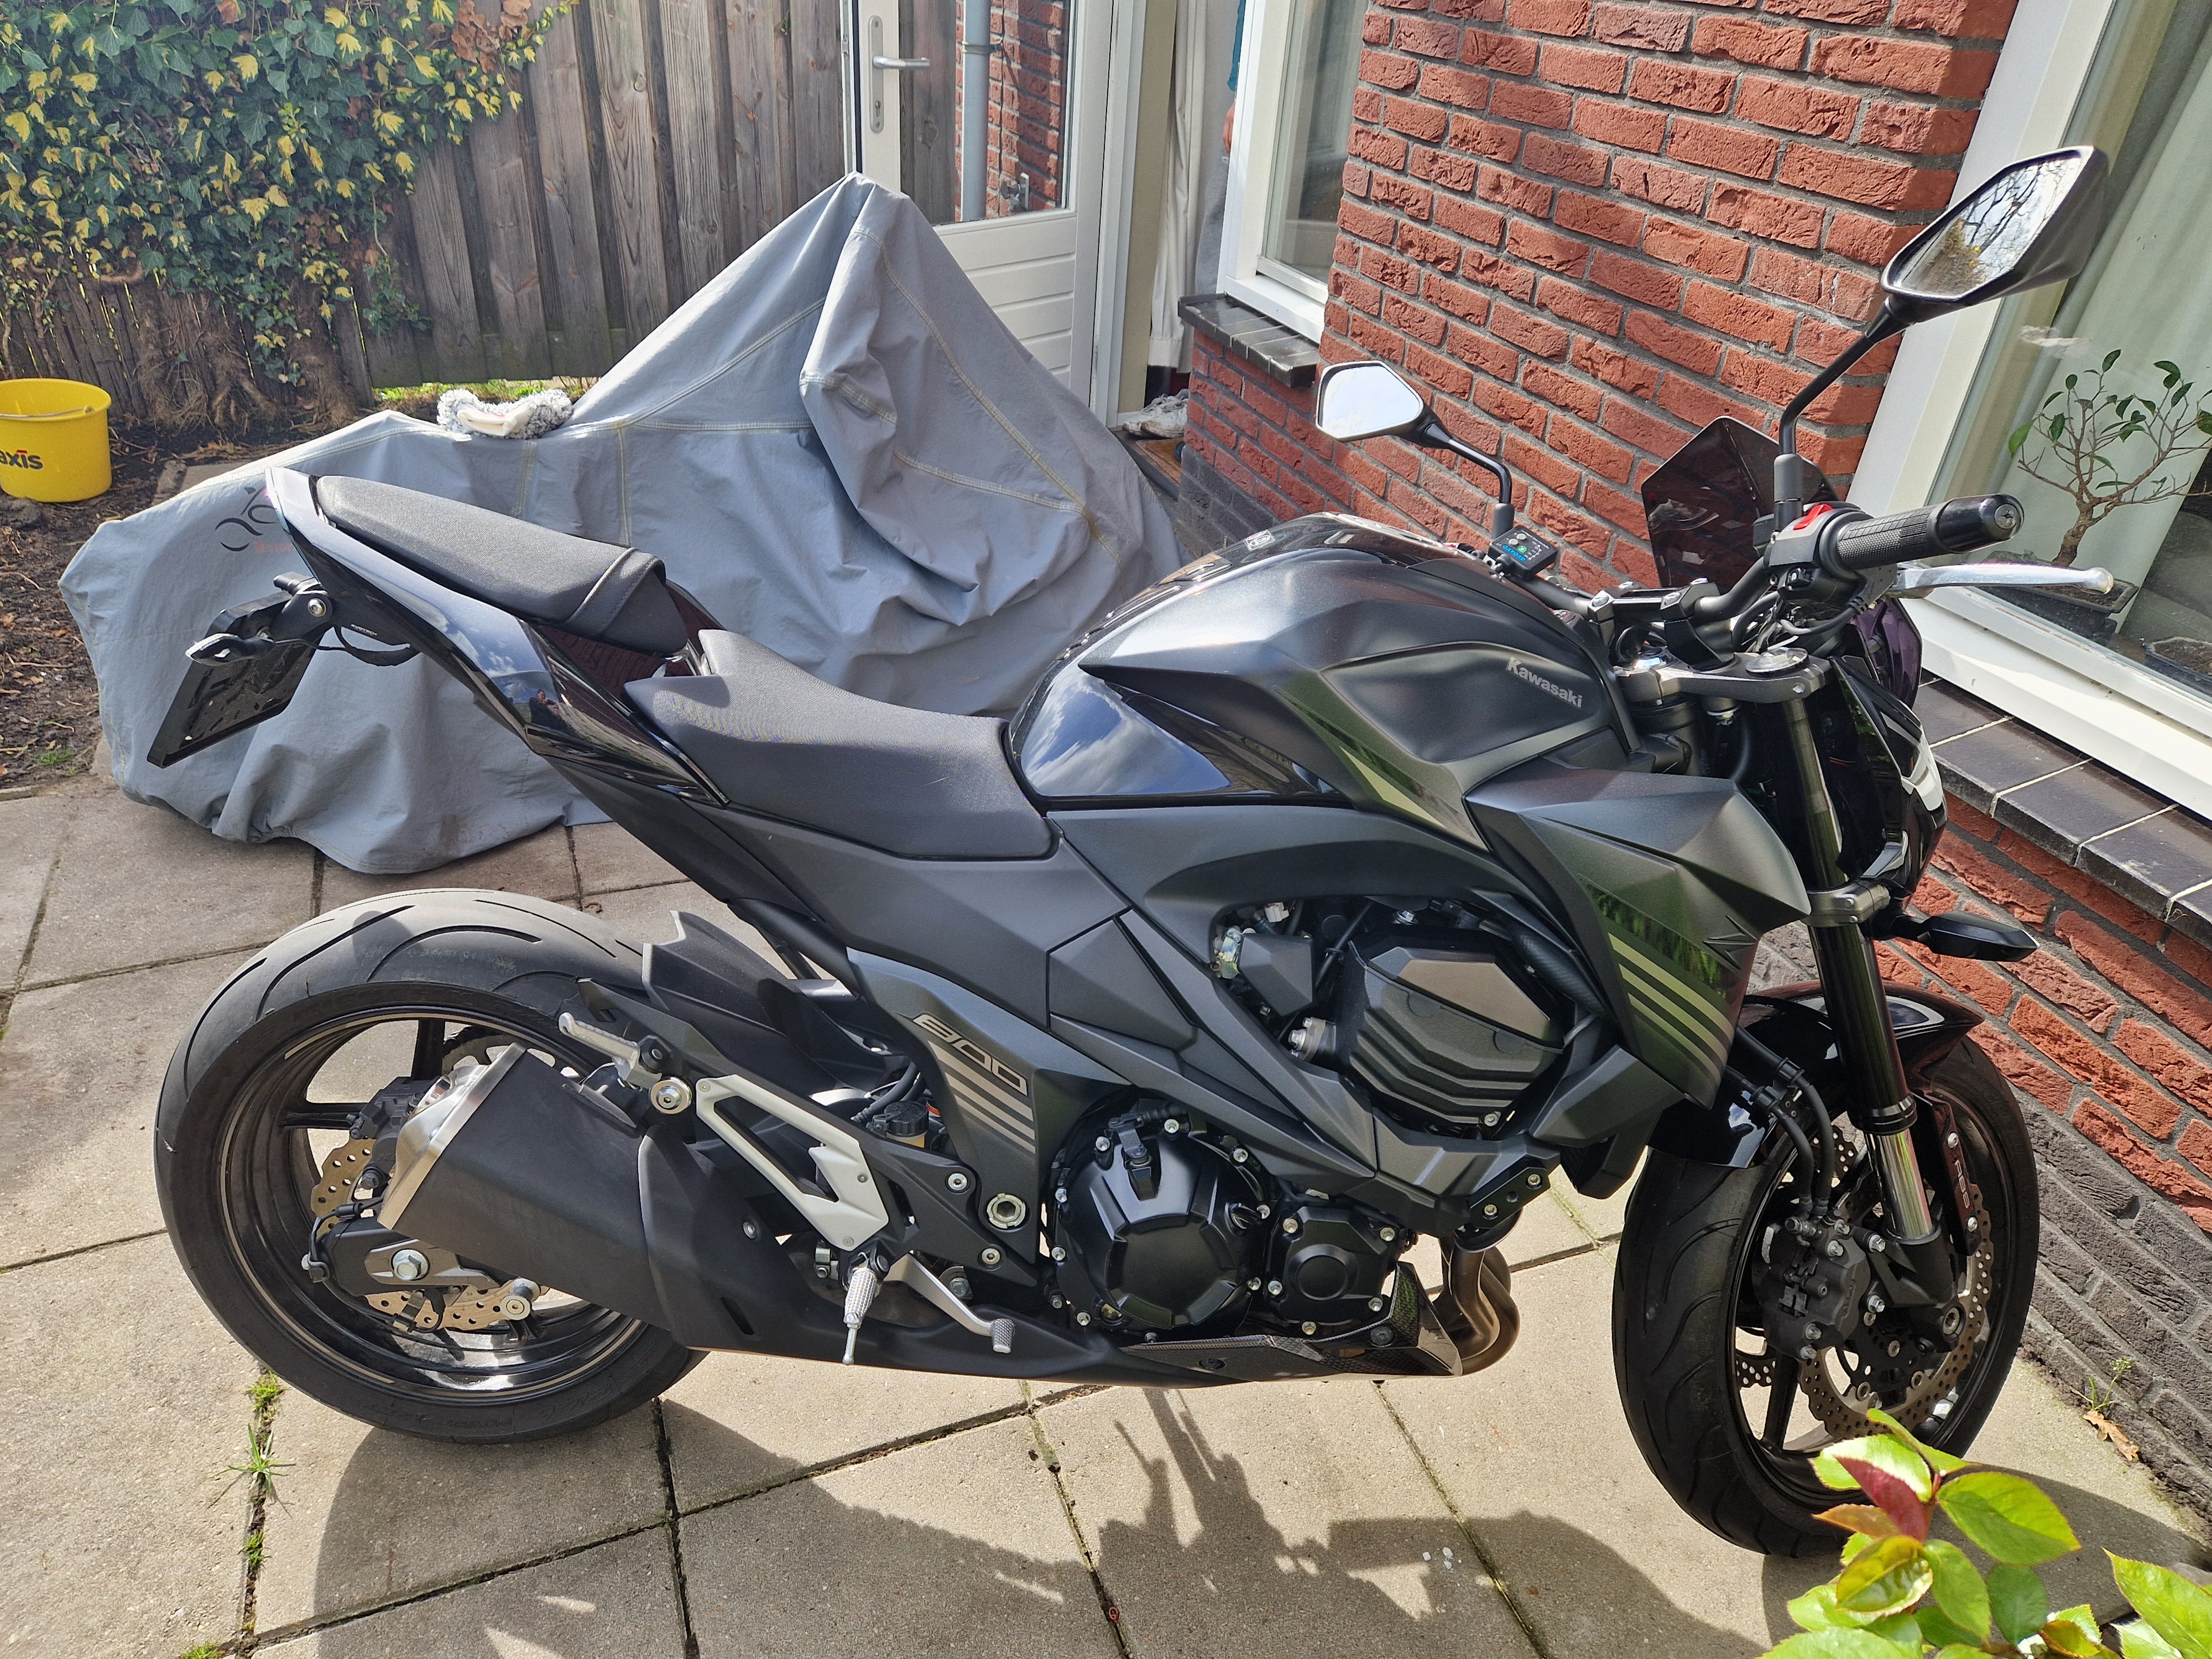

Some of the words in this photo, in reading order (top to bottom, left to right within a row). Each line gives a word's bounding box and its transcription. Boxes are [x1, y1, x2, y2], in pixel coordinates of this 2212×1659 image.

[0, 449, 43, 469] axis
[1503, 544, 1527, 561] OXFORD
[1507, 656, 1583, 708] Kawasaki
[913, 1014, 1028, 1096] 800
[1954, 1159, 1970, 1209] ABS
